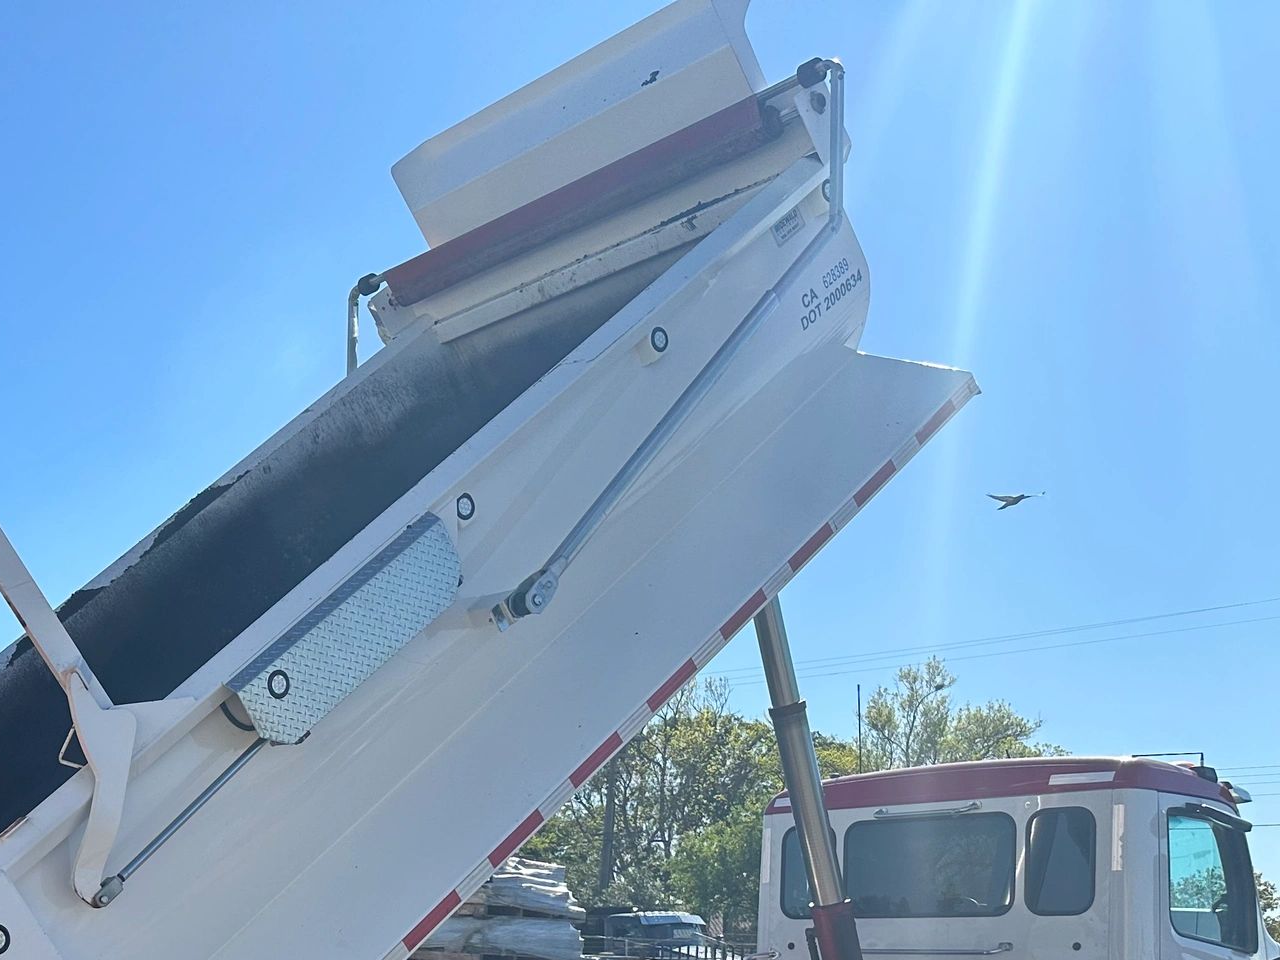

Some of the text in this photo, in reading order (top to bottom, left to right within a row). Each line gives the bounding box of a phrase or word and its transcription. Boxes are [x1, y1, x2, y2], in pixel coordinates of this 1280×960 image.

[800, 268, 863, 331] DOT 2000634
[801, 288, 819, 308] CA
